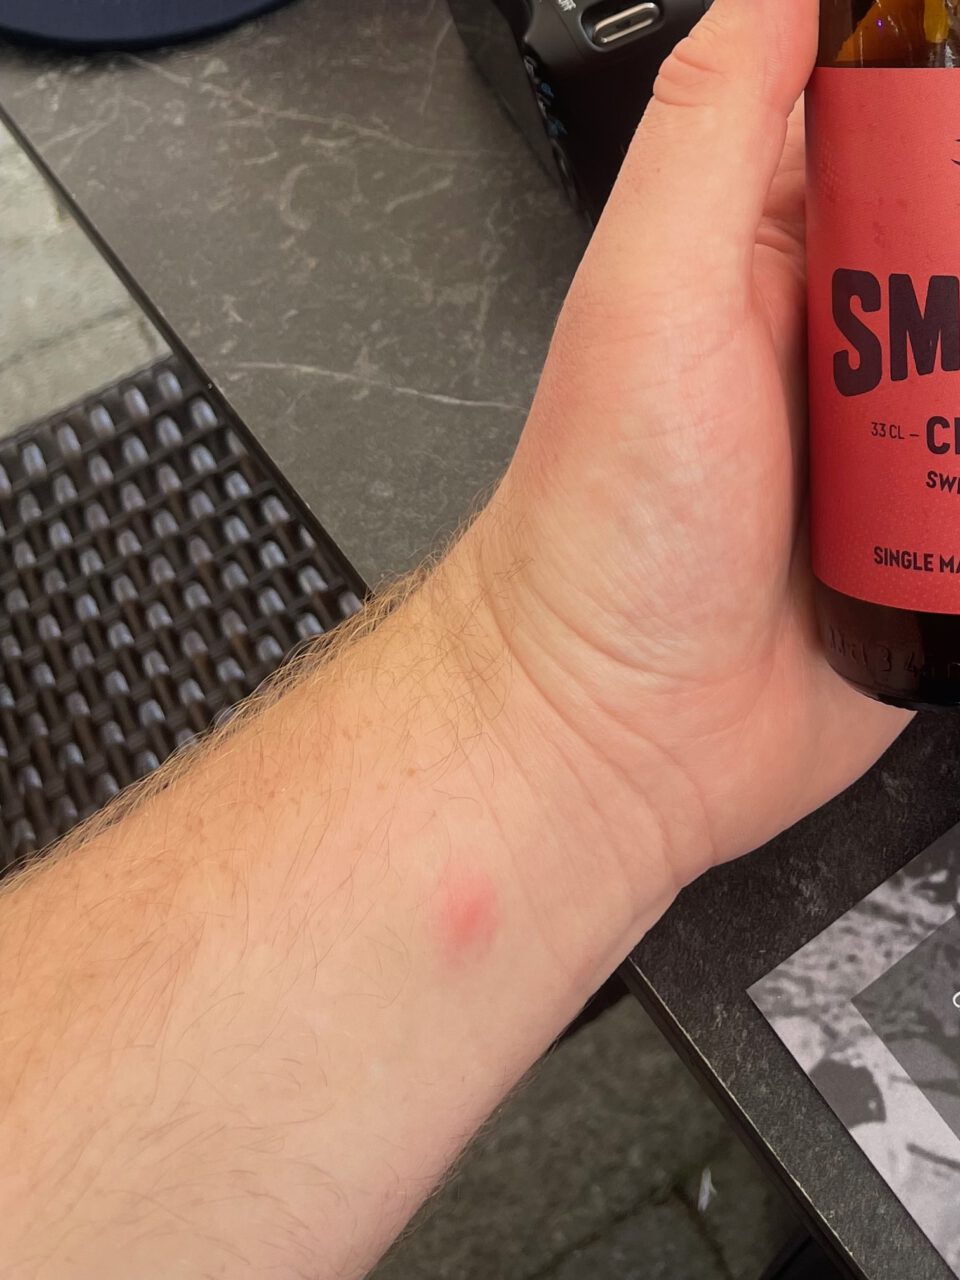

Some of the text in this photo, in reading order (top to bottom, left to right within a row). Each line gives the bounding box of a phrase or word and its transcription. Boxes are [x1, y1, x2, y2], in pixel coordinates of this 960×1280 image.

[871, 422, 886, 437] 33
[889, 424, 905, 440] CL
[873, 546, 934, 573] SINGLE
